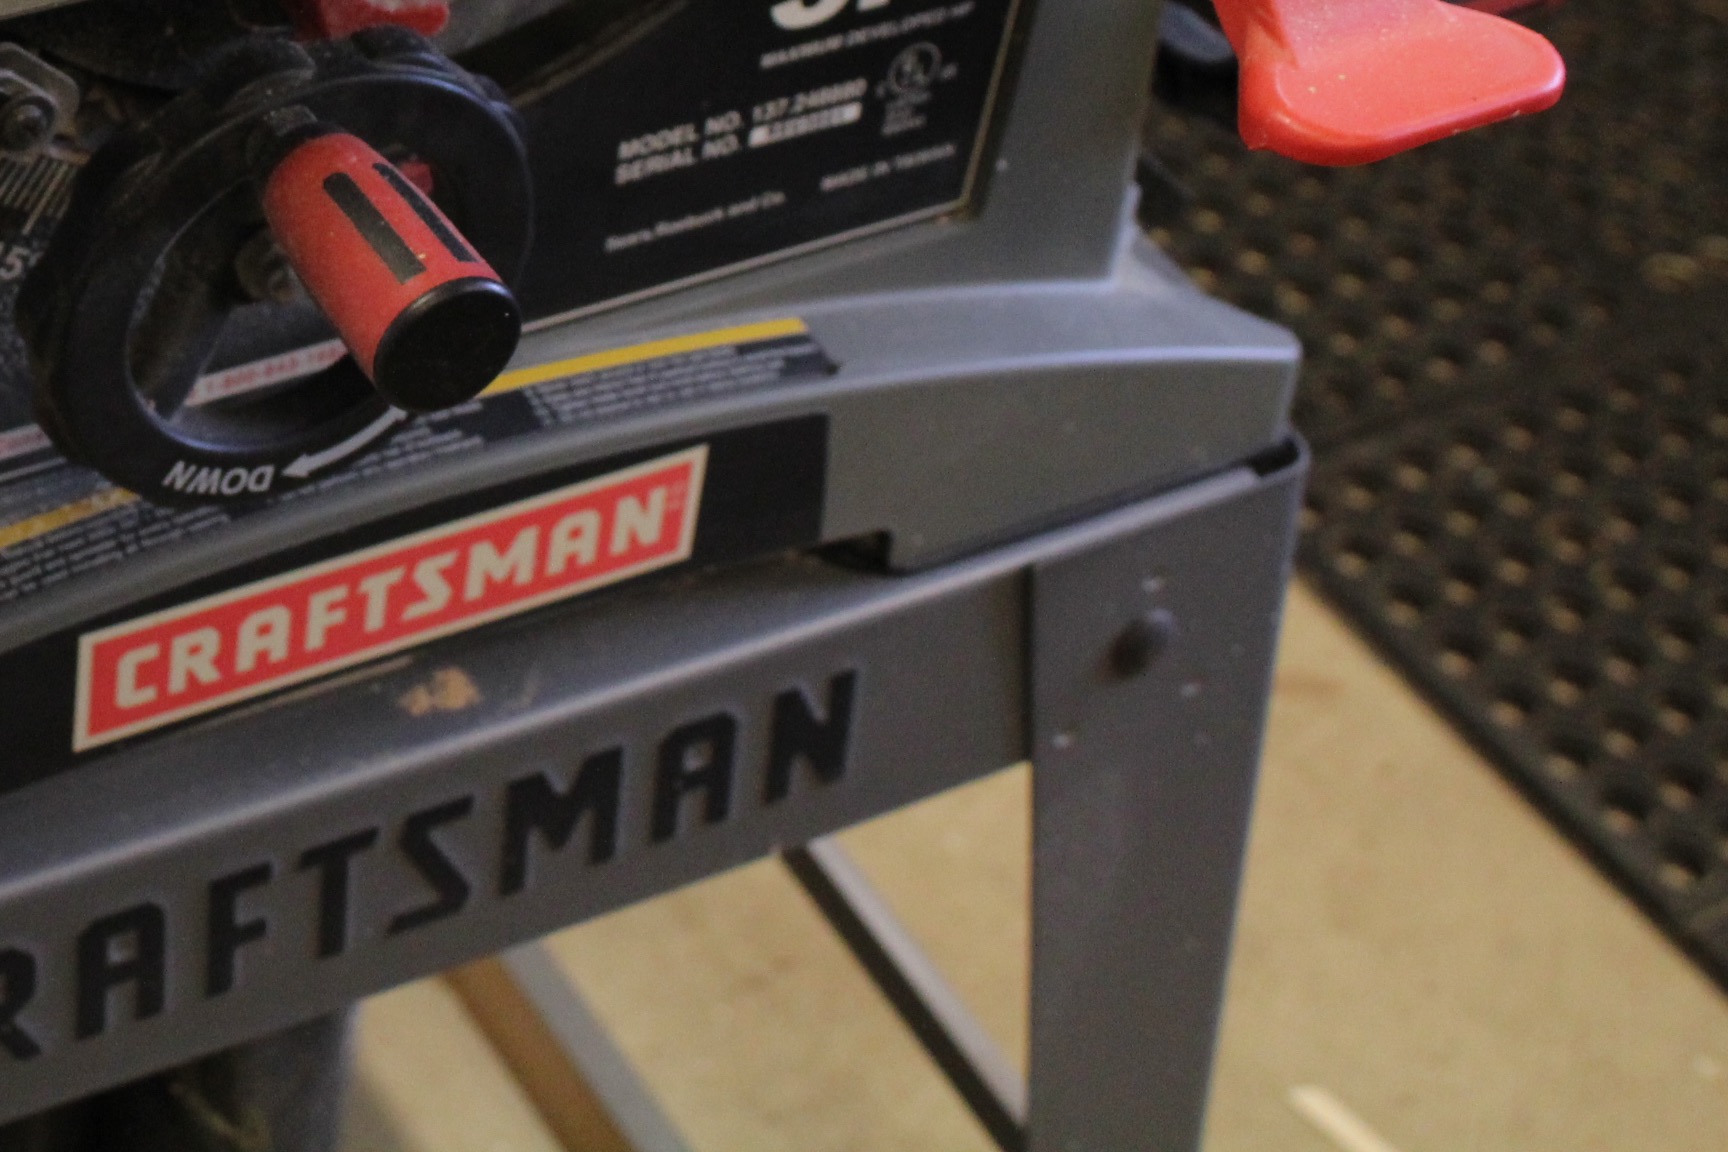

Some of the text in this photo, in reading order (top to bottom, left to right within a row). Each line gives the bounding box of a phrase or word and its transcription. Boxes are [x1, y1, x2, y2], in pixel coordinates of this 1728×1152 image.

[618, 123, 700, 160] MODEL
[614, 147, 696, 186] SERIAL
[162, 460, 275, 495] DOWN
[113, 484, 669, 710] CRAFTSMAN
